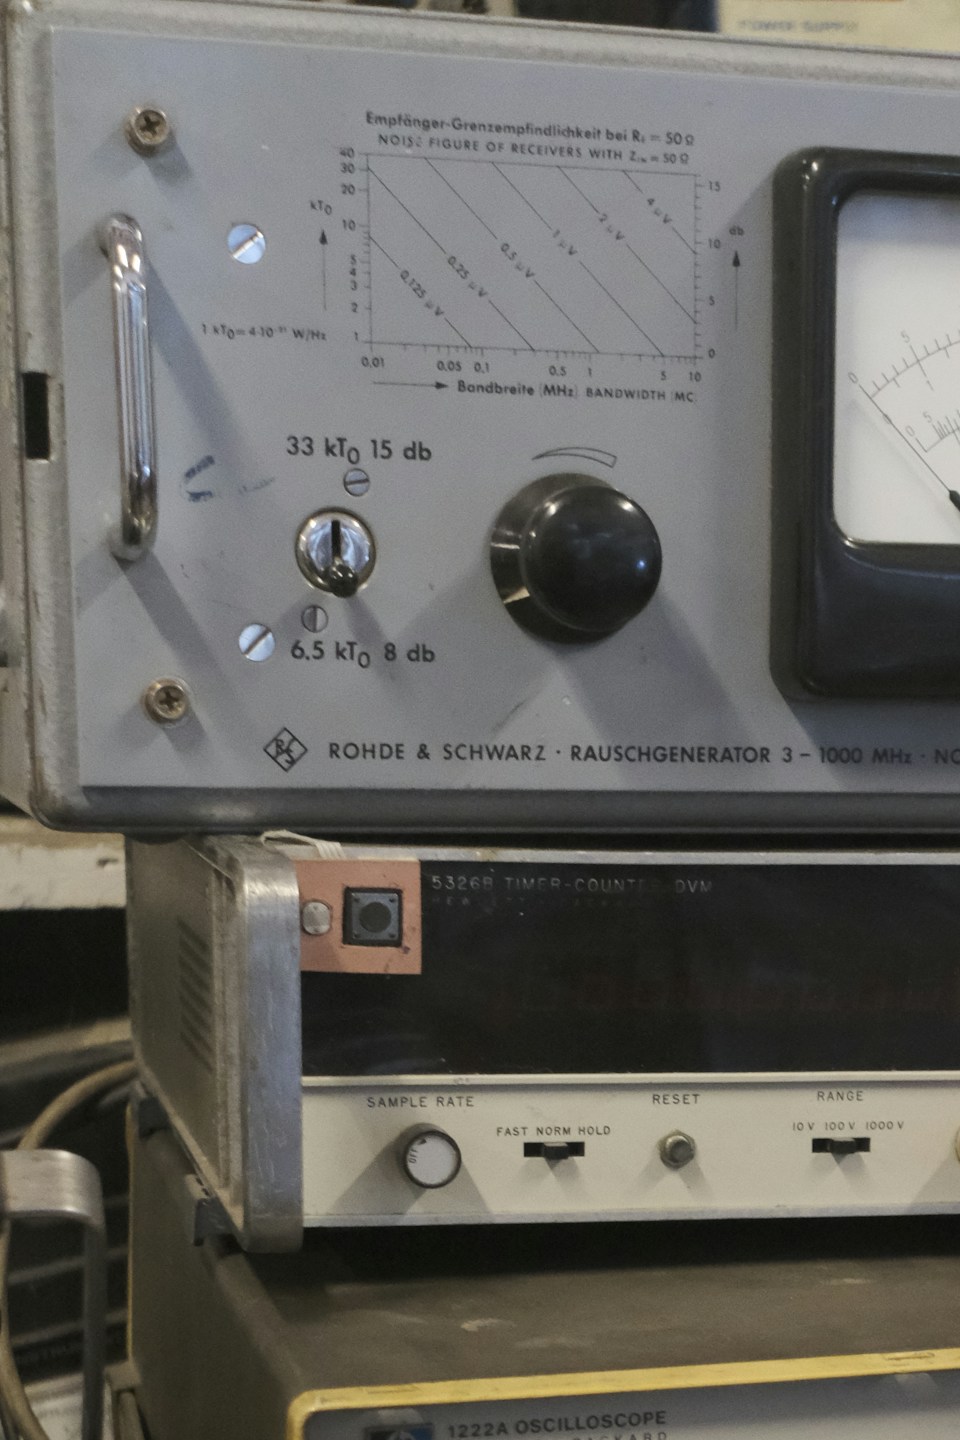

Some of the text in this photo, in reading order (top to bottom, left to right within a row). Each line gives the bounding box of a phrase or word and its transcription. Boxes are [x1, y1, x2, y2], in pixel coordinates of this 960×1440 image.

[366, 111, 627, 141] Empfänger-Grenzempfindlichkeit bei
[429, 138, 479, 150] FIGURE
[486, 141, 504, 152] OF
[511, 143, 582, 158] RECEIVERS
[589, 148, 622, 161] WITH
[729, 225, 744, 237] db
[292, 328, 327, 341] W/Hz
[361, 356, 490, 374] 0.01 0.05 0.1
[457, 379, 535, 397] Bandbreite
[586, 386, 665, 401] BANDWIDTH
[287, 436, 431, 461] 33 15 db
[291, 641, 435, 662] 6.5 db
[329, 743, 405, 760] ROHDE
[417, 743, 431, 760] &
[443, 743, 546, 761] SCHWARZ
[571, 745, 770, 764] RAUSCHGENERATOR
[782, 748, 792, 764] 3
[819, 748, 863, 764] 1000
[872, 748, 912, 765] MHz
[675, 879, 713, 893] DVM
[367, 1096, 475, 1108] SAMPLE RATE
[652, 1093, 701, 1105] RESET
[817, 1090, 864, 1101] RANGE
[496, 1126, 611, 1136] FAST NORM HOLD
[449, 1410, 667, 1439] 1222A OSCILLOSCOPE
